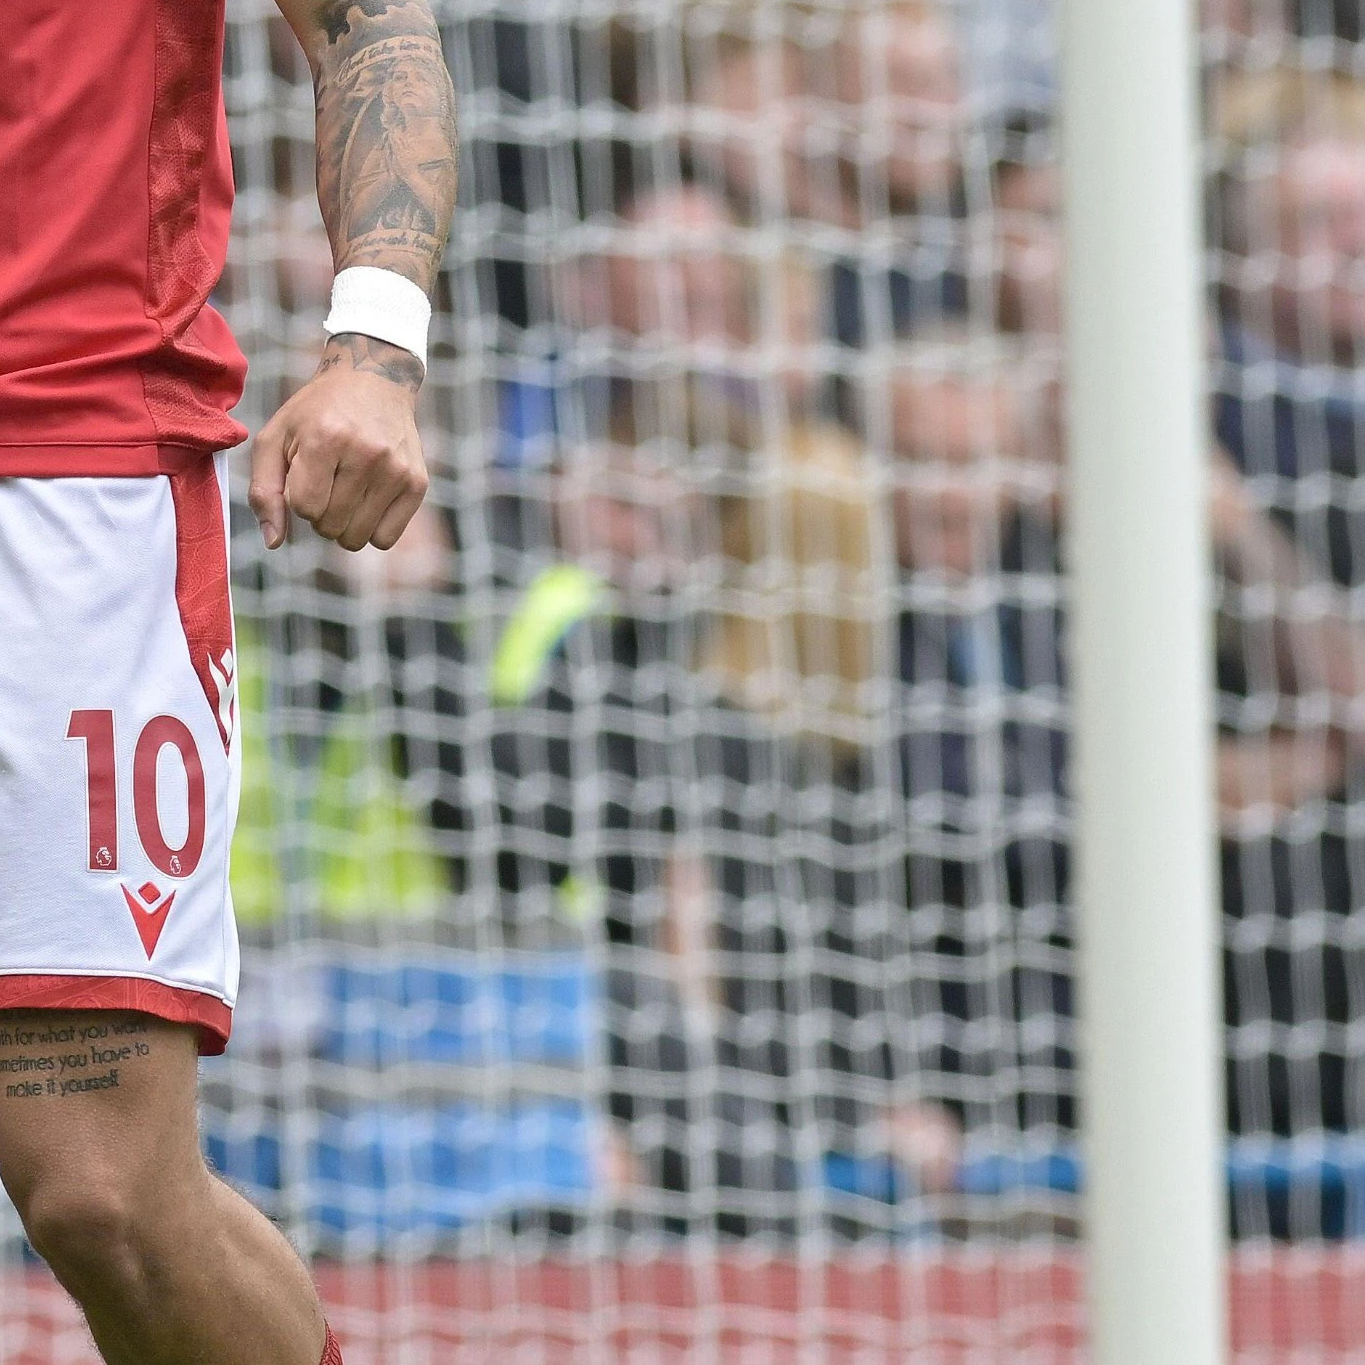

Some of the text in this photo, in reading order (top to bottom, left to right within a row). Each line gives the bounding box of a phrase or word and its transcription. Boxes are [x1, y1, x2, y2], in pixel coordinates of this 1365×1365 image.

[64, 708, 207, 881] 10
[15, 1027, 35, 1046] for
[39, 1025, 74, 1044] what
[78, 1025, 108, 1044] you
[58, 1052, 88, 1075] you
[91, 1046, 132, 1065] have
[134, 1042, 150, 1057] to
[5, 1080, 42, 1098] make
[46, 1078, 58, 1095] it
